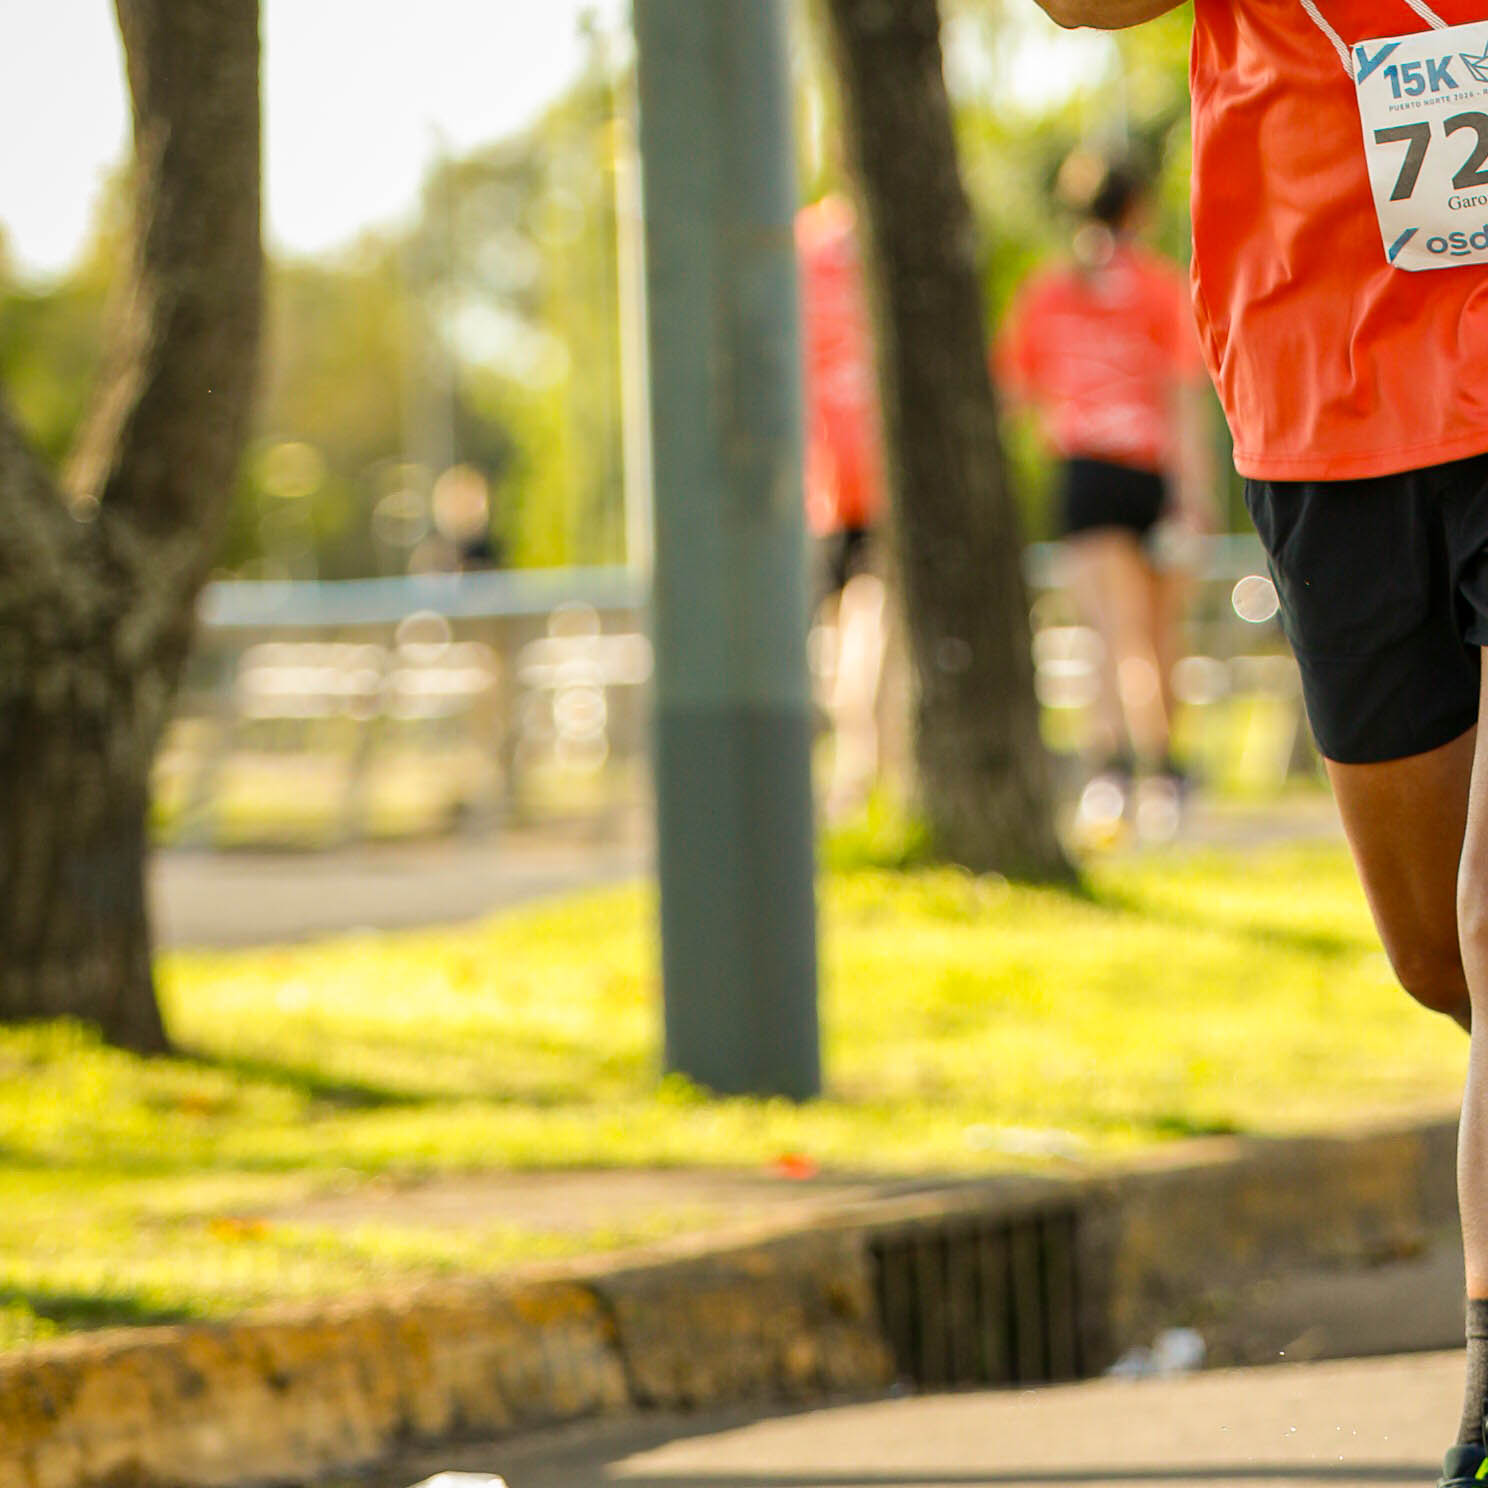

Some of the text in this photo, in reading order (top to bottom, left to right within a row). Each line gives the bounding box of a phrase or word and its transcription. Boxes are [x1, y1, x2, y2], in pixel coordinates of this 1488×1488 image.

[1383, 55, 1459, 99] 15K
[1388, 101, 1421, 113] PUERTO
[1423, 95, 1451, 105] NORTE
